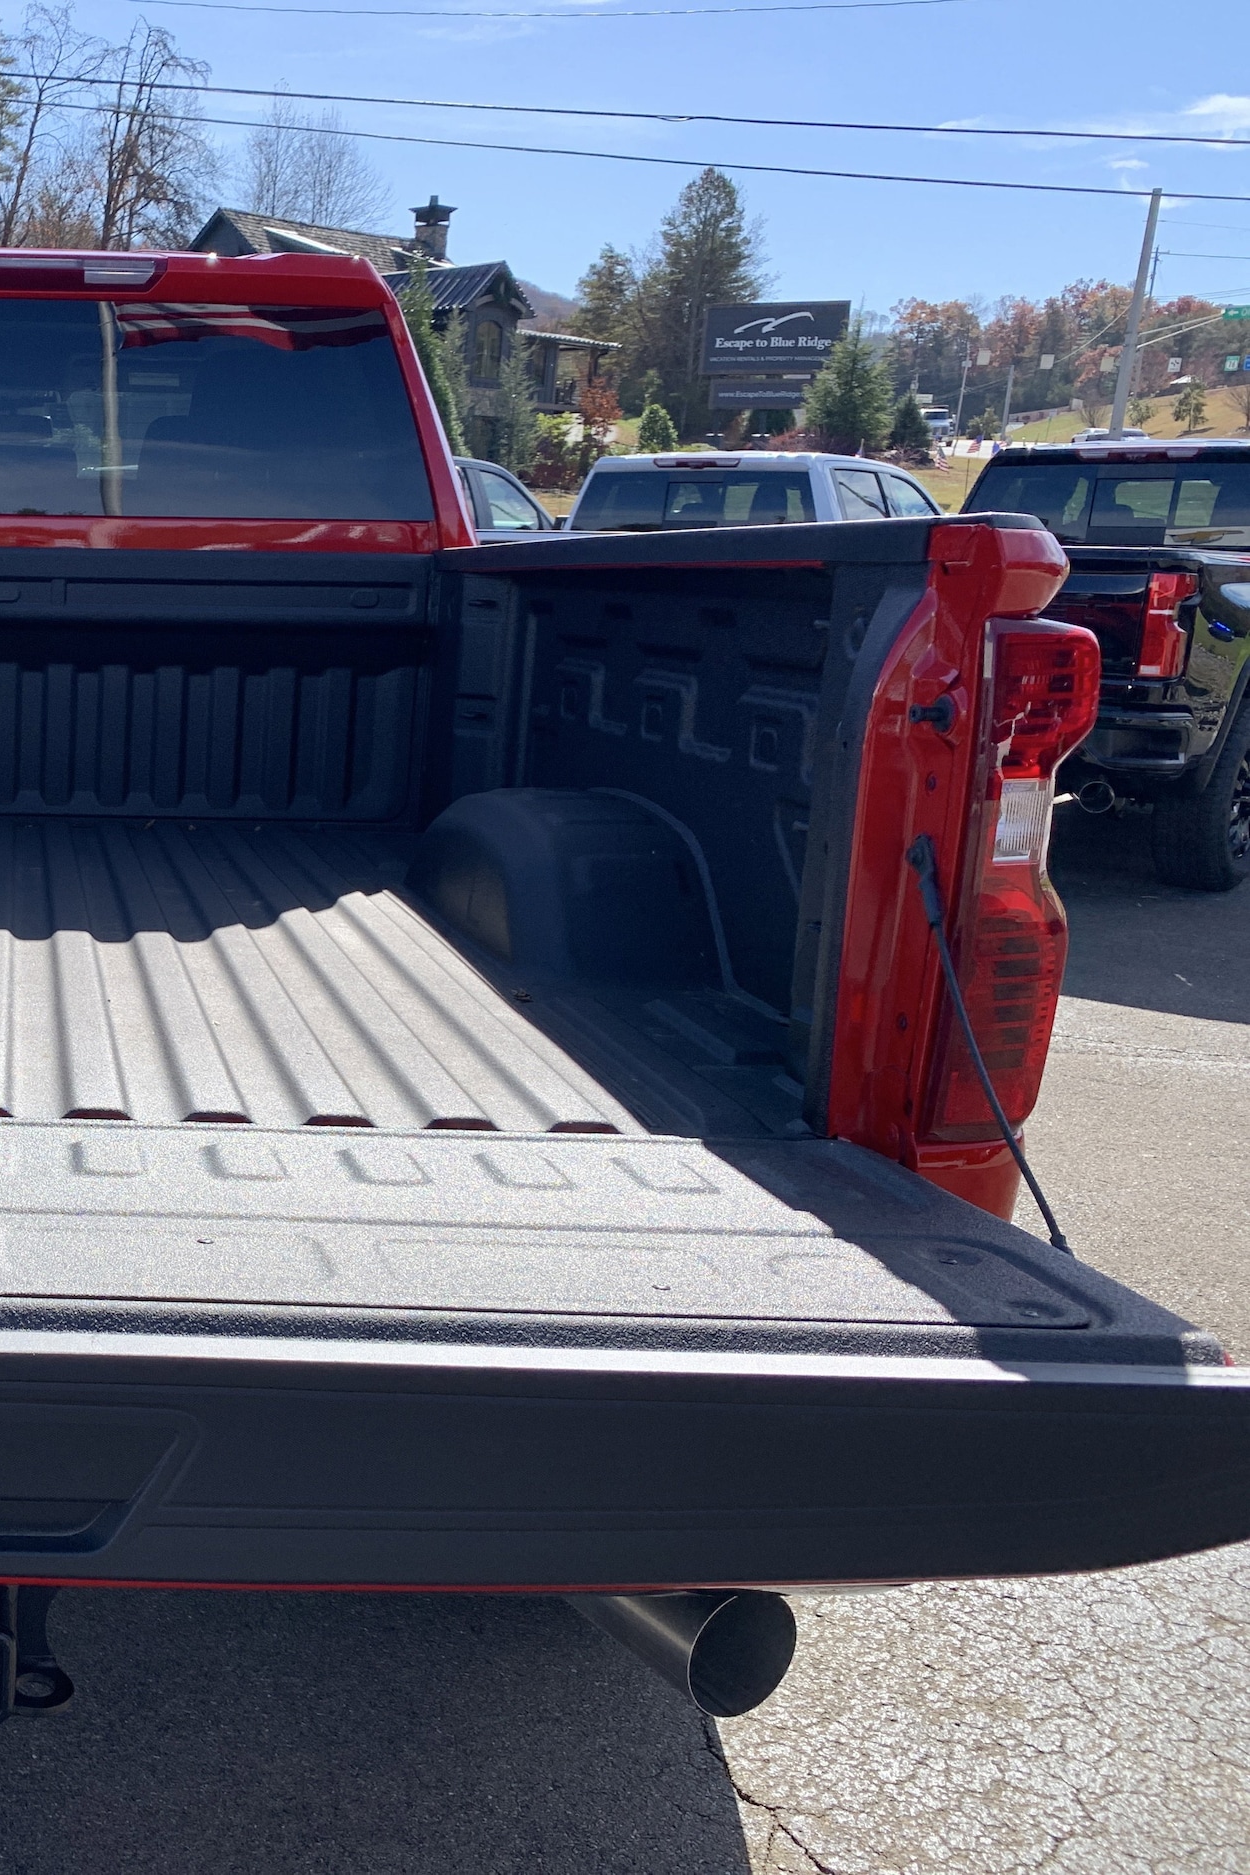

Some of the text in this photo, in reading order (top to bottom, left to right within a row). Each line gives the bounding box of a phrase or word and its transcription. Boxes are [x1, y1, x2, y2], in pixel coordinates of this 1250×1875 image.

[715, 336, 832, 351] Escape to Blue Ridge
